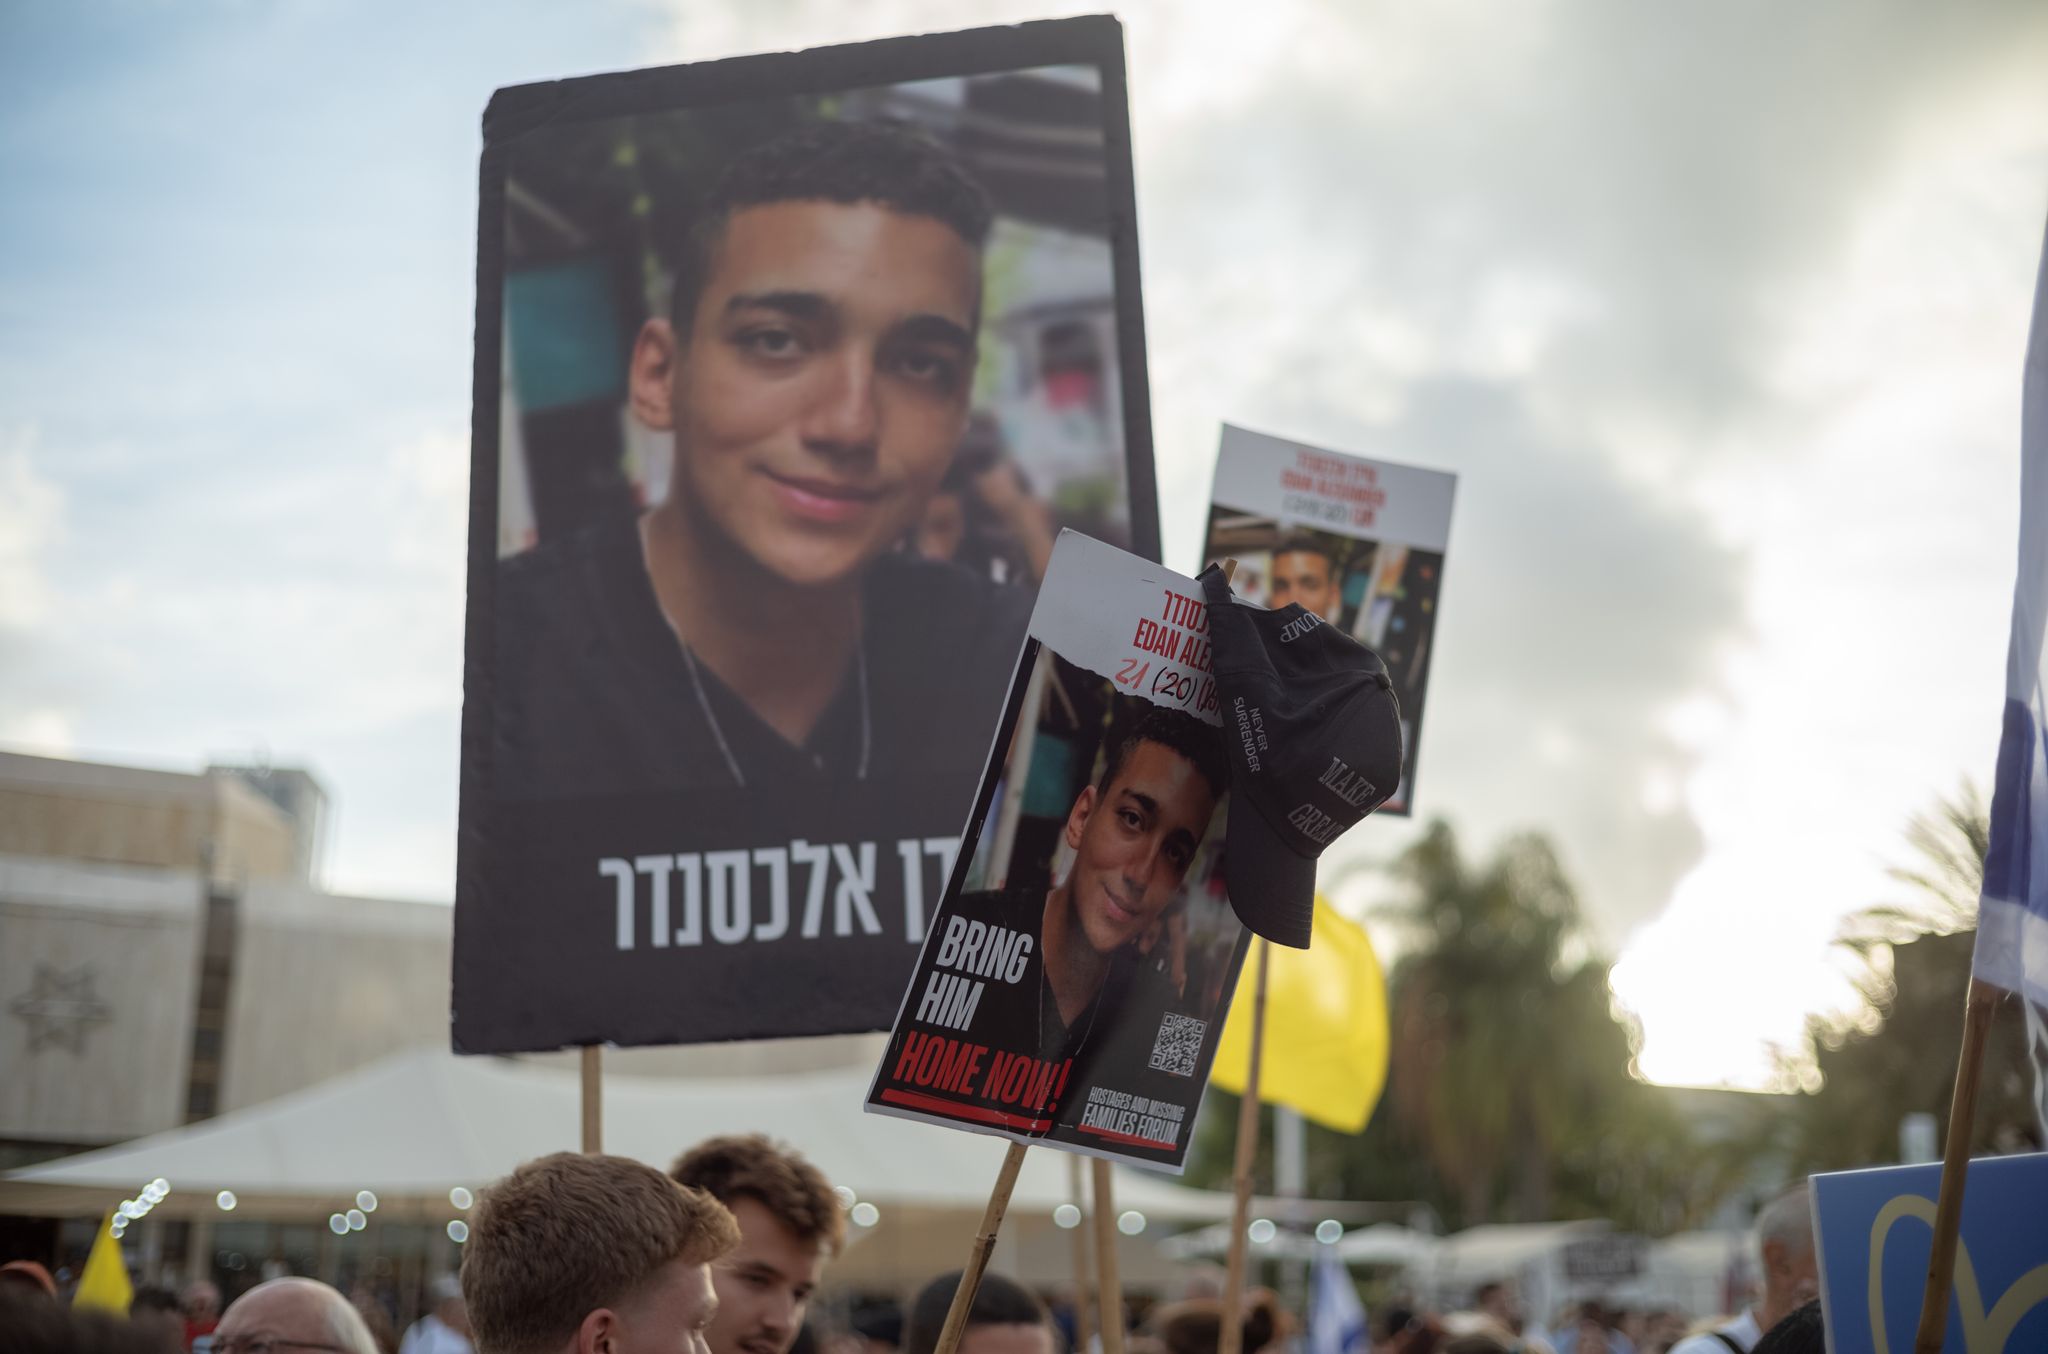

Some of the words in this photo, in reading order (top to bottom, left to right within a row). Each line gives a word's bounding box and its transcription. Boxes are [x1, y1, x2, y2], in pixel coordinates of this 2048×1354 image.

[1162, 589, 1210, 636] כסנדר
[1133, 617, 1181, 660] EDAN
[1115, 658, 1150, 689] 21
[1151, 666, 1198, 707] (20)
[1233, 696, 1261, 773] SURRENDER
[1249, 707, 1268, 752] NEVER
[1318, 756, 1376, 807] MAKE
[599, 839, 883, 950] אלכסנדר
[936, 914, 1034, 984] BRING
[915, 970, 985, 1031] HIM
[892, 1030, 989, 1095] HOME
[981, 1050, 1073, 1113] NOW!
[1081, 1103, 1138, 1135] FAMILIES
[1136, 1115, 1181, 1145] FORUM
[1088, 1086, 1133, 1110] HOSTAGES
[1130, 1095, 1149, 1114] AND
[1147, 1099, 1186, 1122] MISSING
